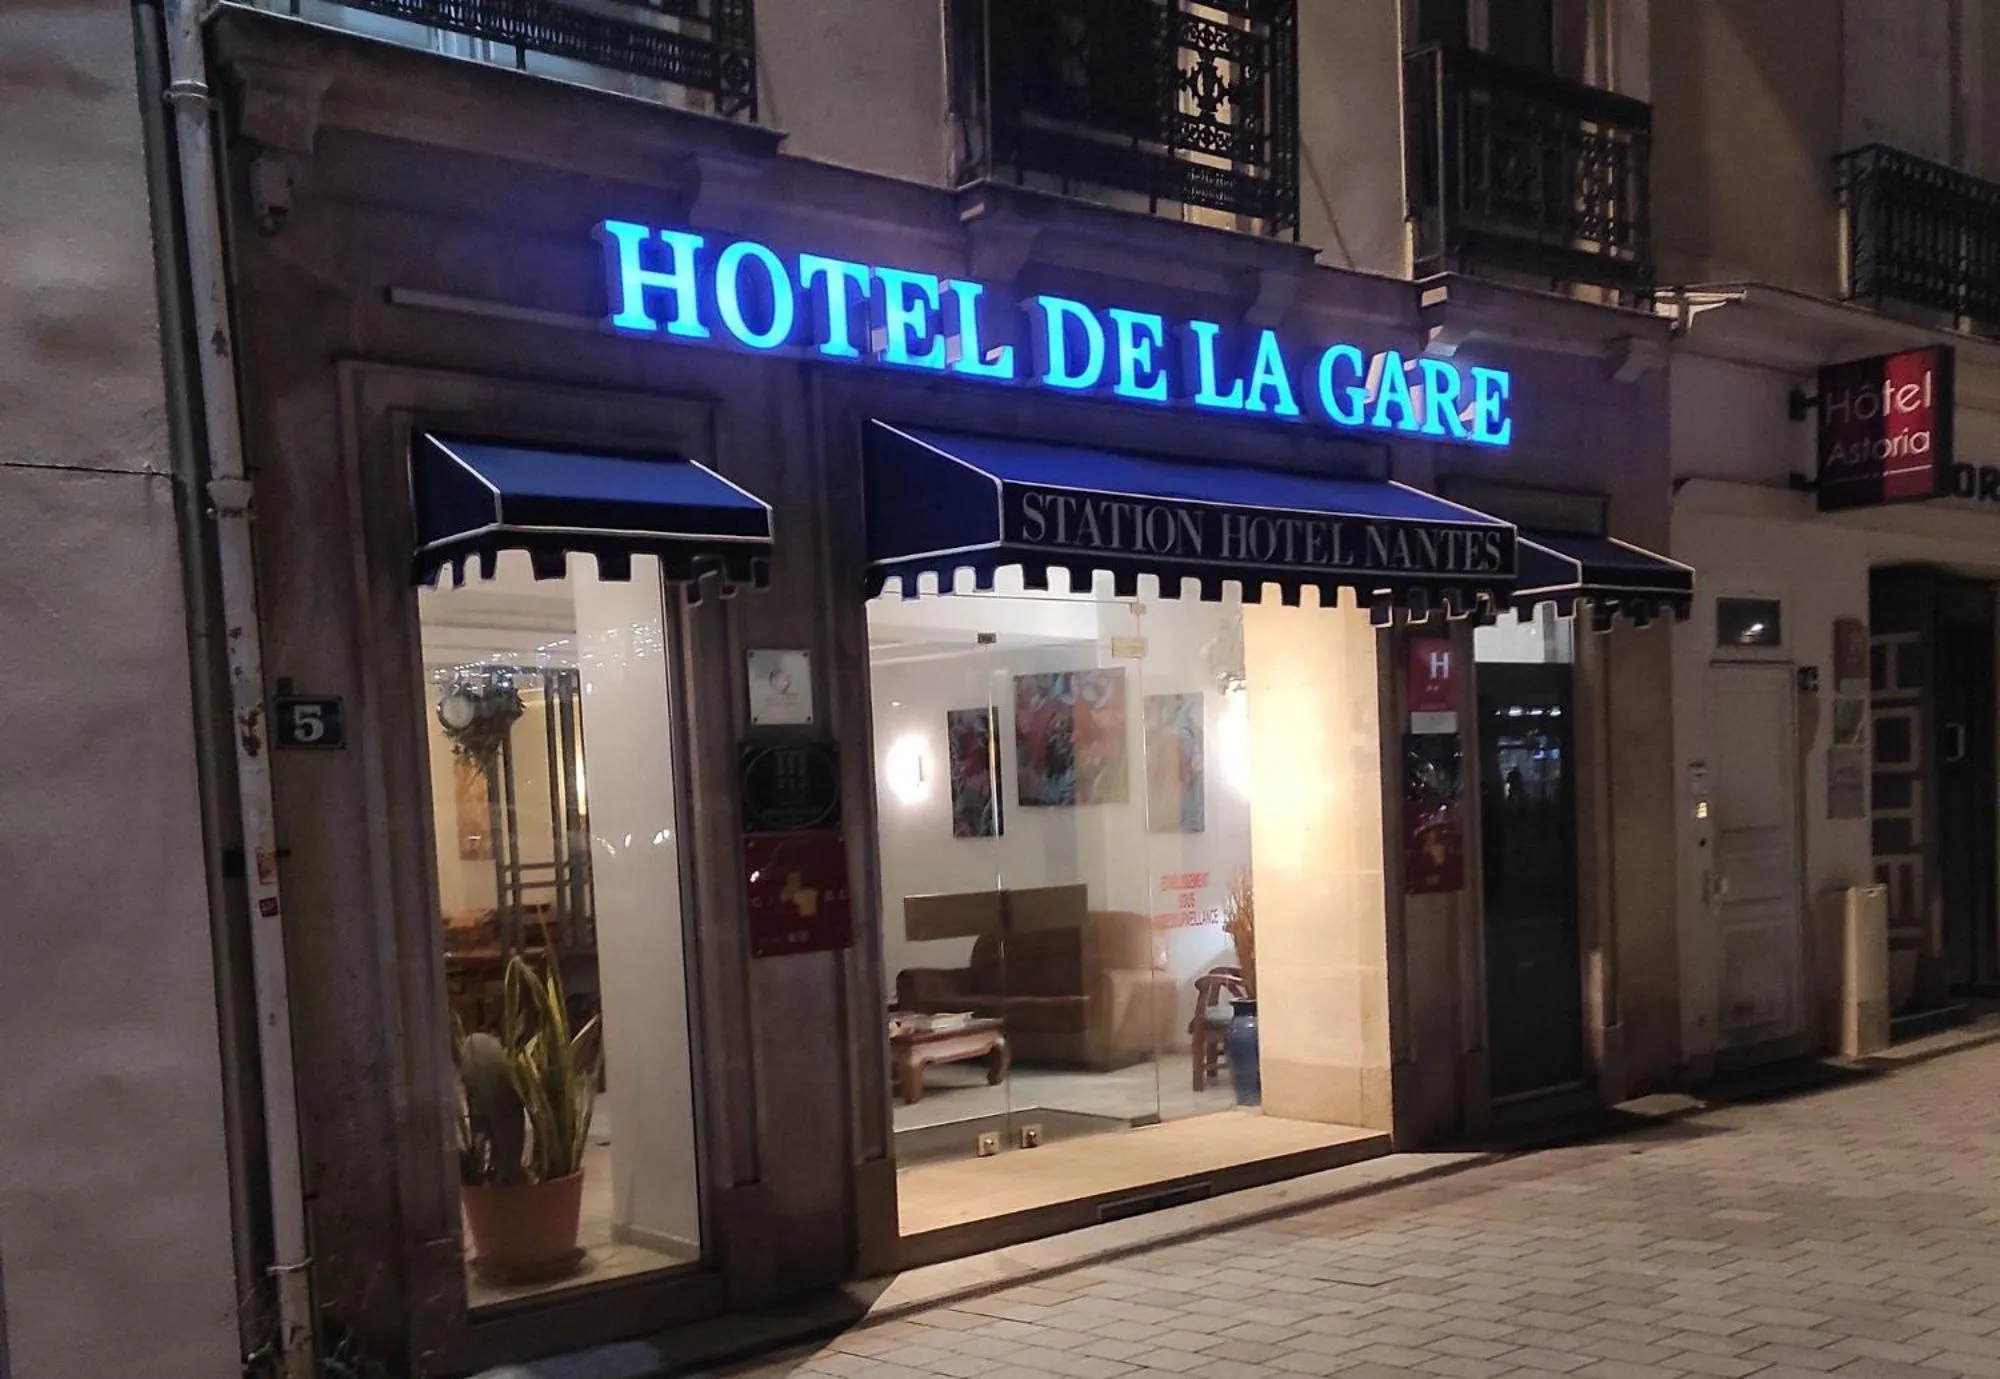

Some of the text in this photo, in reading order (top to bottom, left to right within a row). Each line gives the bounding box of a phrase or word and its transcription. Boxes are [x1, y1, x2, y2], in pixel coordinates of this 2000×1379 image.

[605, 220, 1511, 445] HOTEL DE LA GARE
[1826, 370, 1933, 426] Hôtel
[1826, 427, 1931, 466] Astoria
[1022, 491, 1502, 571] STATION HOTEL NANTES
[1430, 652, 1450, 679] H
[294, 704, 324, 742] 5
